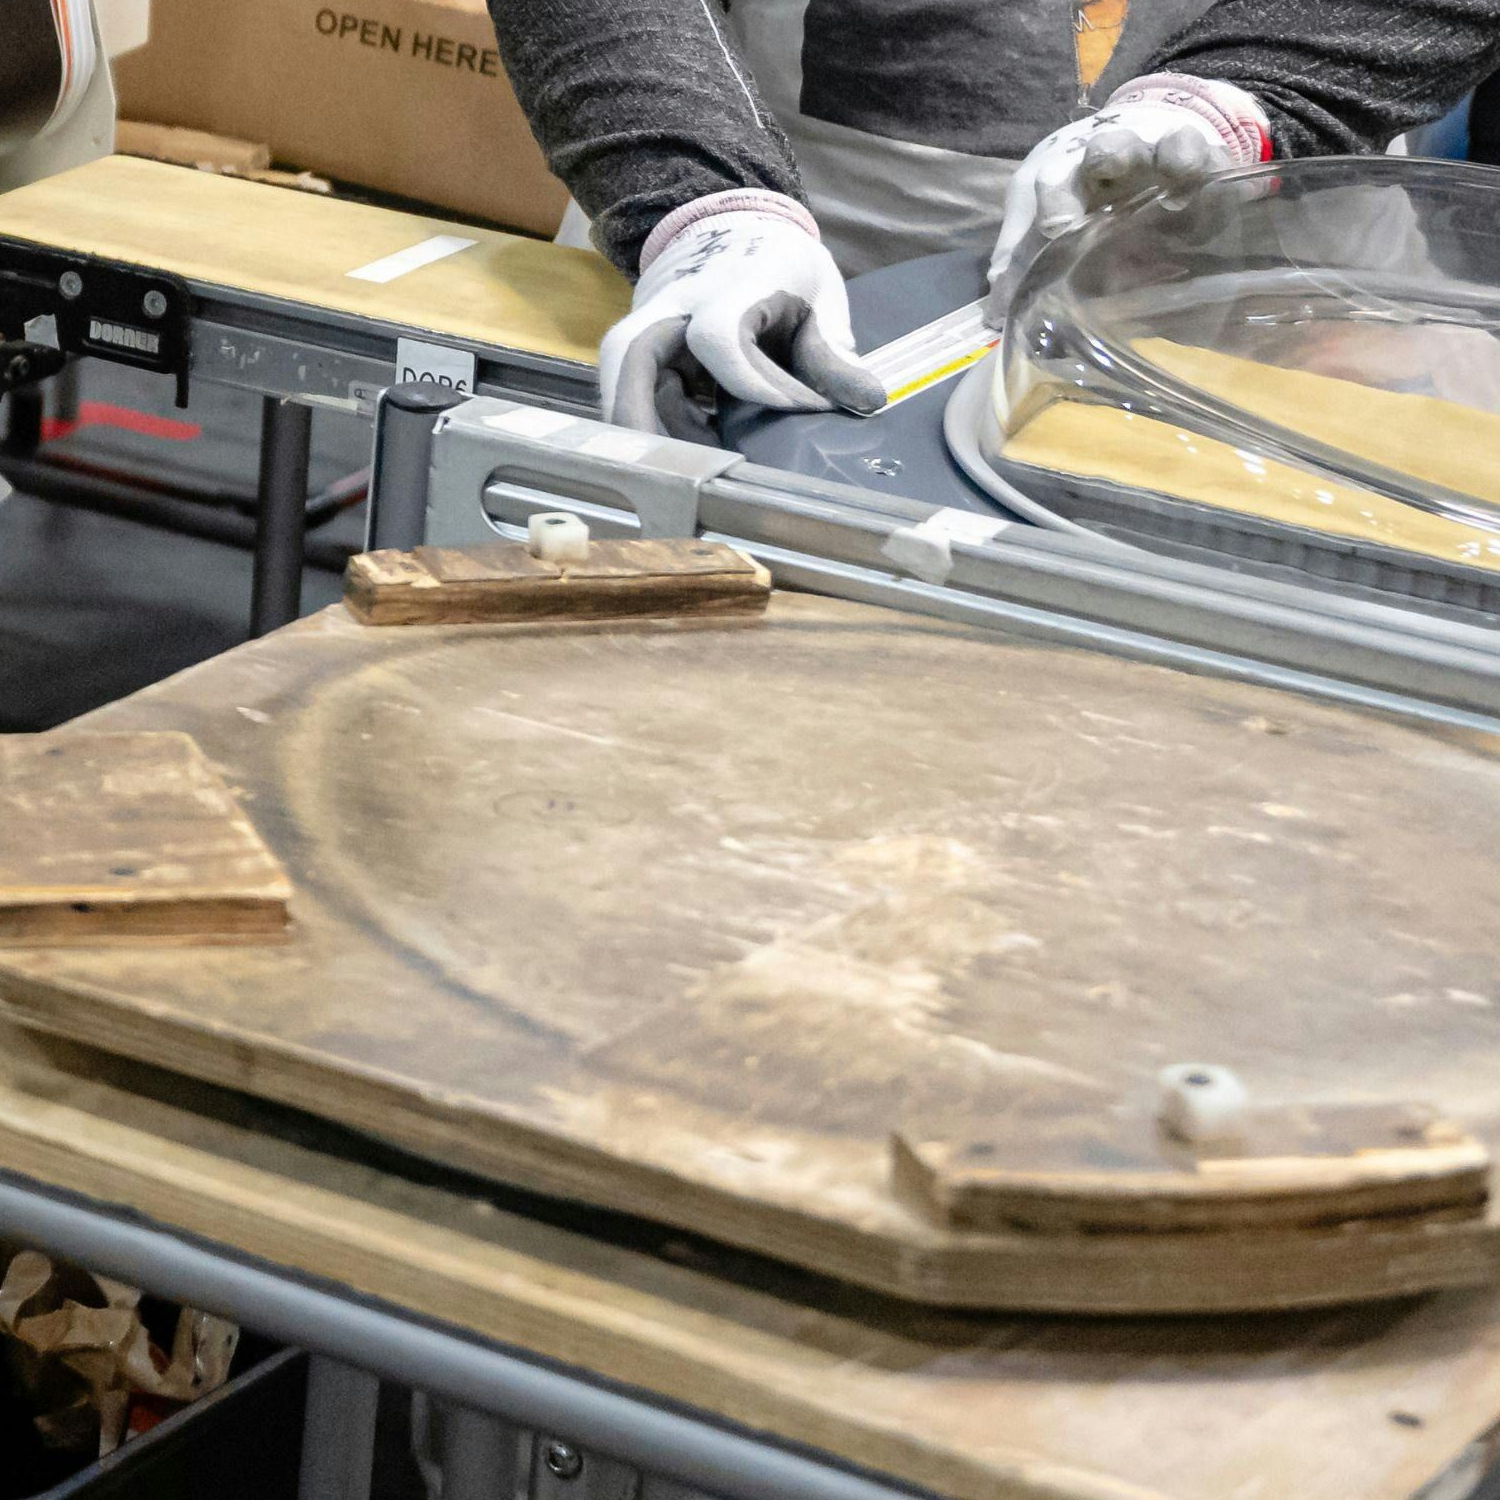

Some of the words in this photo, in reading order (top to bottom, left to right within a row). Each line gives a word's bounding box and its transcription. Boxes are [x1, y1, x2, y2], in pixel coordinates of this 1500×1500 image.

[315, 7, 402, 53] OPEN
[411, 29, 500, 77] HERE
[89, 320, 159, 353] DORNER
